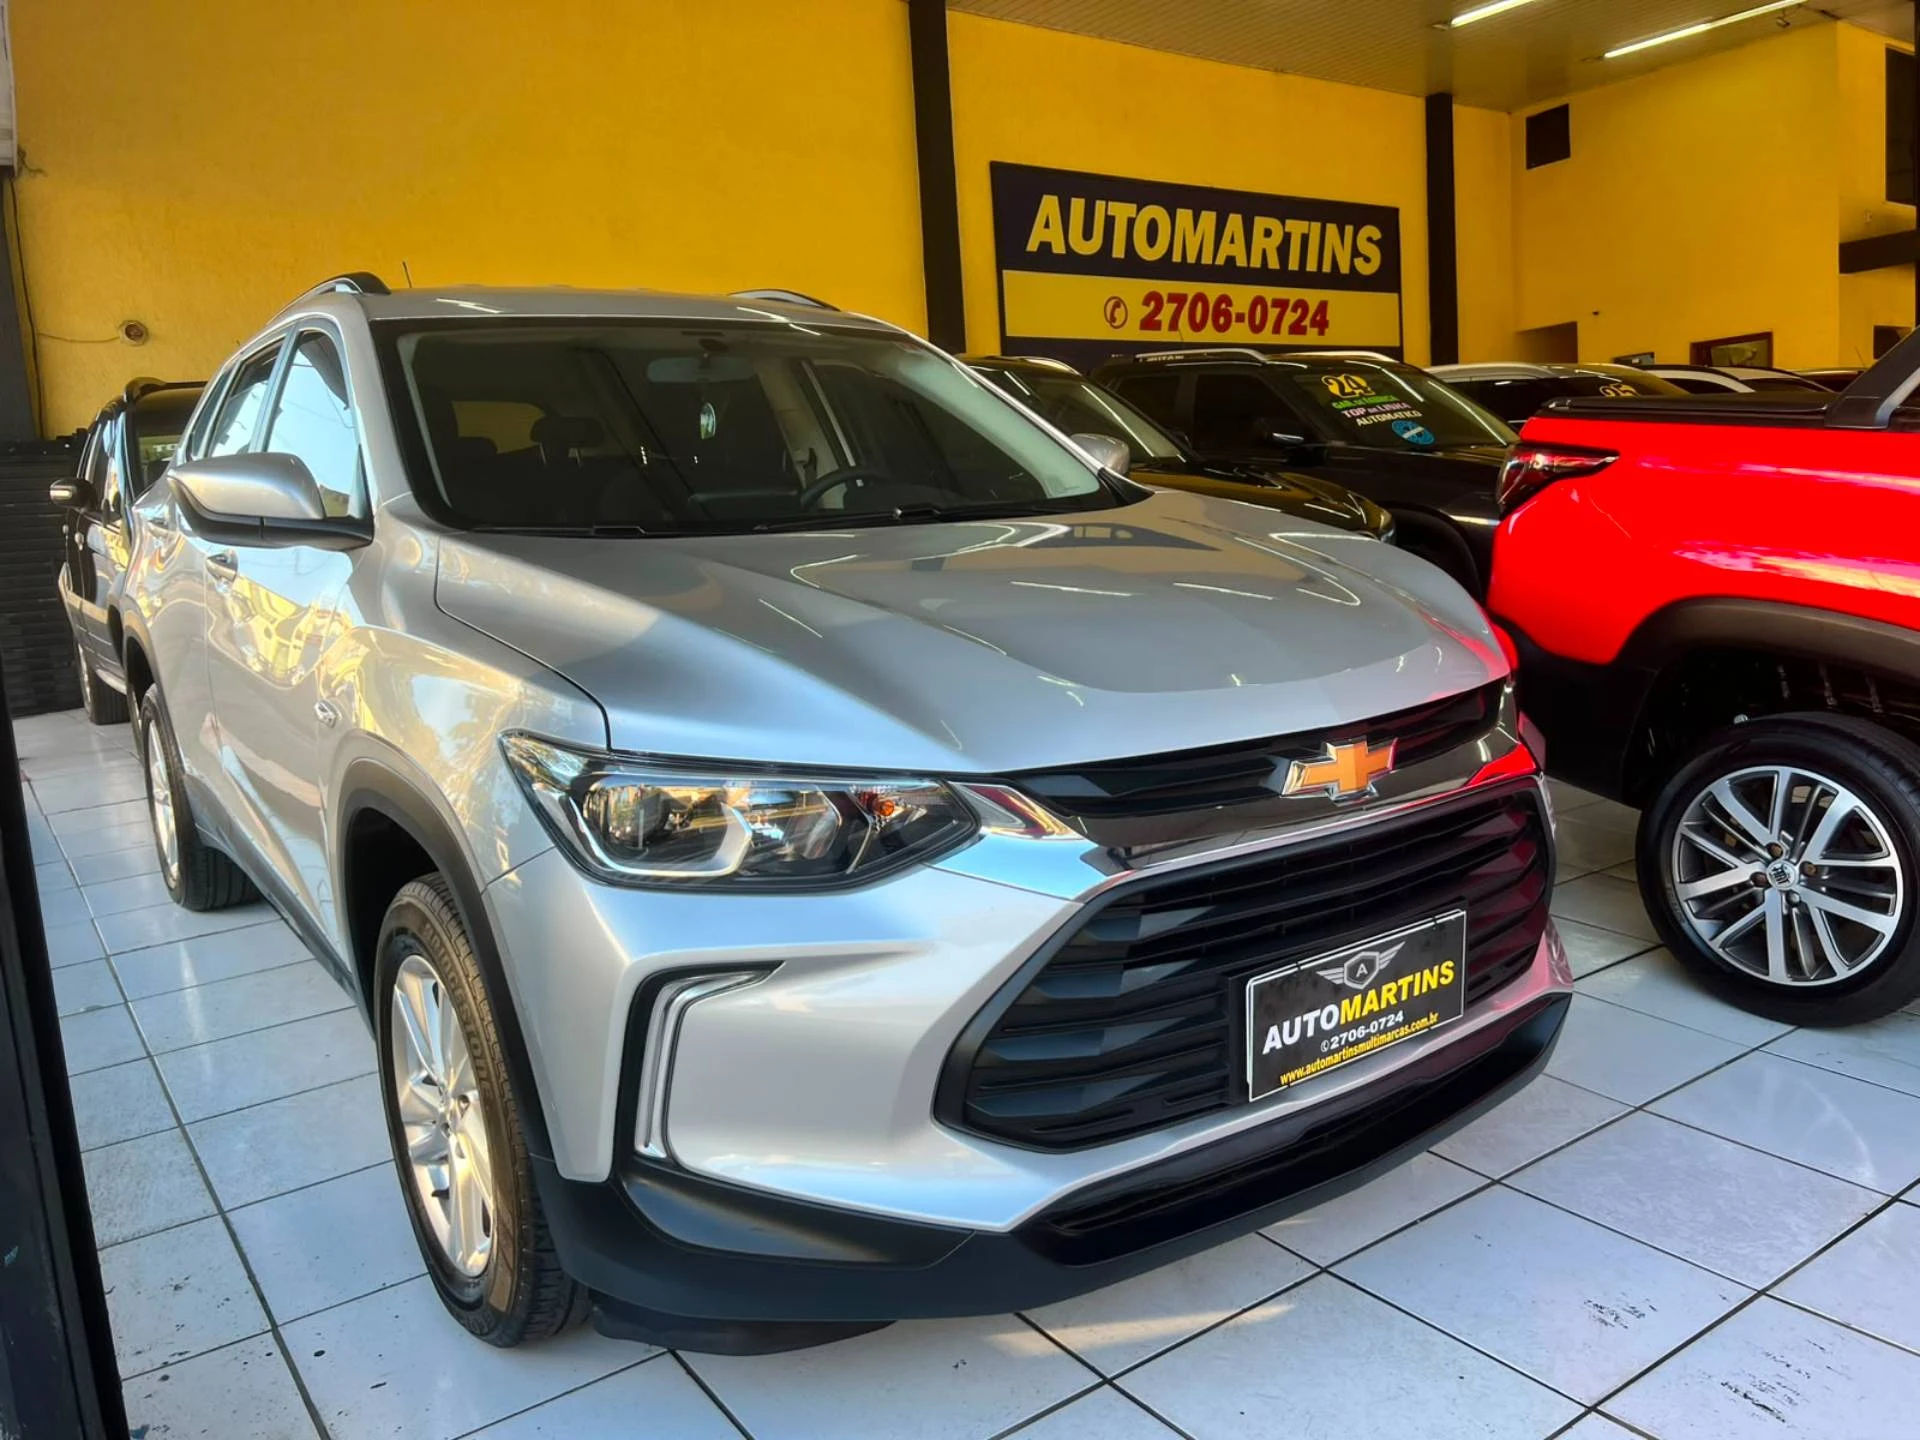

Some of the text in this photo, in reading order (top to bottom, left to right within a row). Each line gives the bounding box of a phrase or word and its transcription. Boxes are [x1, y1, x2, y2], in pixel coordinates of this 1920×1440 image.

[1026, 194, 1382, 276] AUTOMARTINS
[1139, 291, 1330, 337] 2706-0724
[1321, 374, 1376, 398] 24
[1341, 407, 1367, 418] TOP
[1262, 960, 1455, 1055] AUTOMARTINS
[1330, 1010, 1404, 1049] 2706-0724
[1279, 1011, 1440, 1086] www.automartinsmultimarcas.com.br
